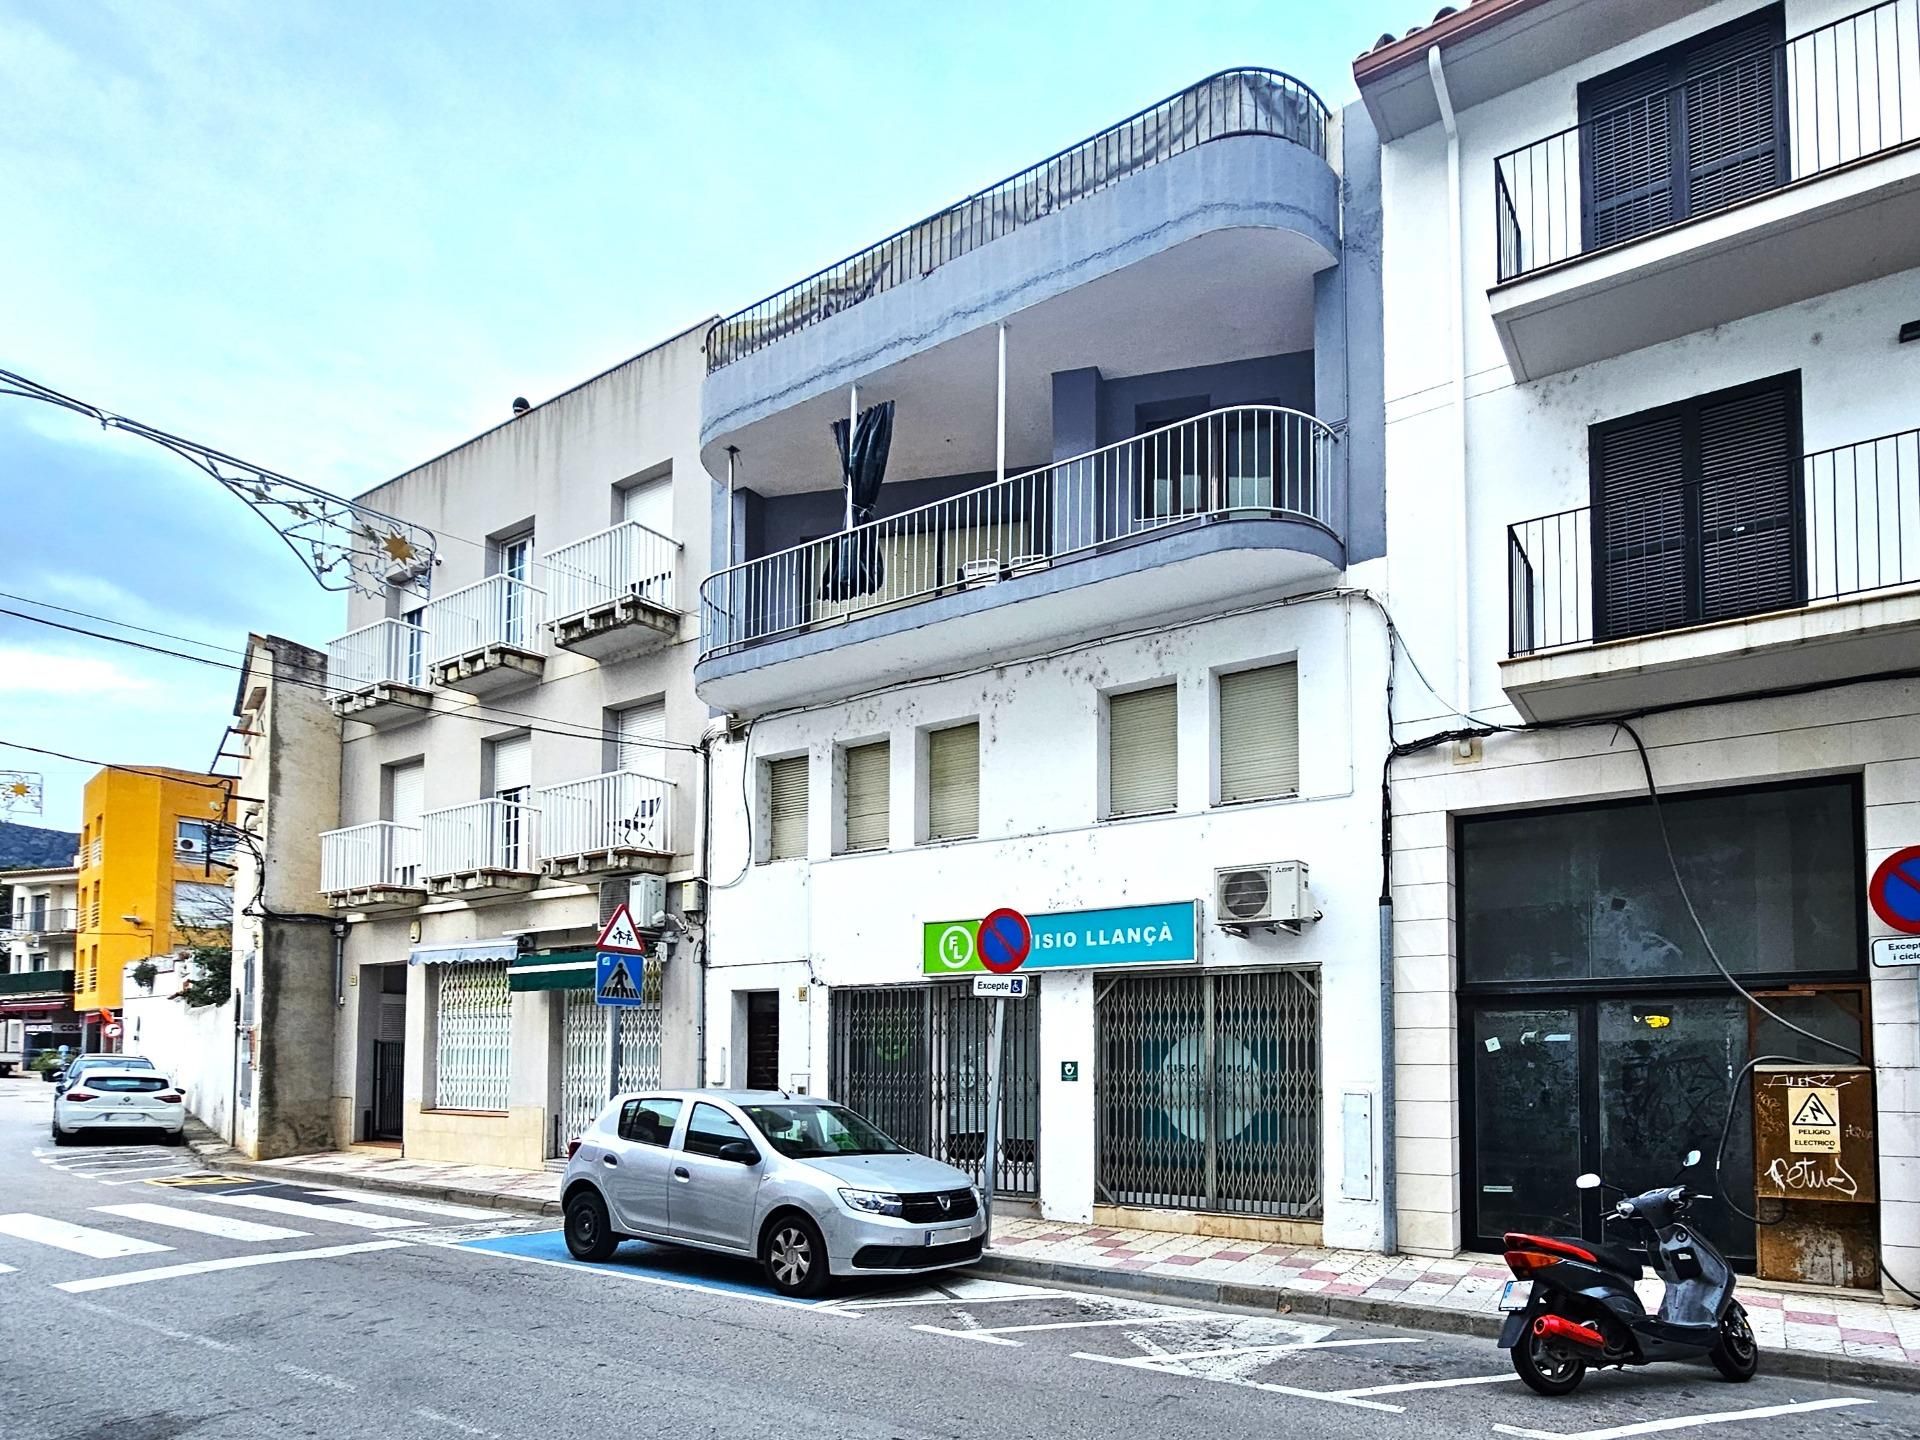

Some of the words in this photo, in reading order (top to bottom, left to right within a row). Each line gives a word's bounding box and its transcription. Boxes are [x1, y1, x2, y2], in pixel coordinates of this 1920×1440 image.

[1034, 932, 1078, 949] ISIO
[1086, 921, 1173, 946] LLANÇÀ
[977, 981, 1009, 991] Excepte
[1794, 1139, 1836, 1147] ELECTRICO
